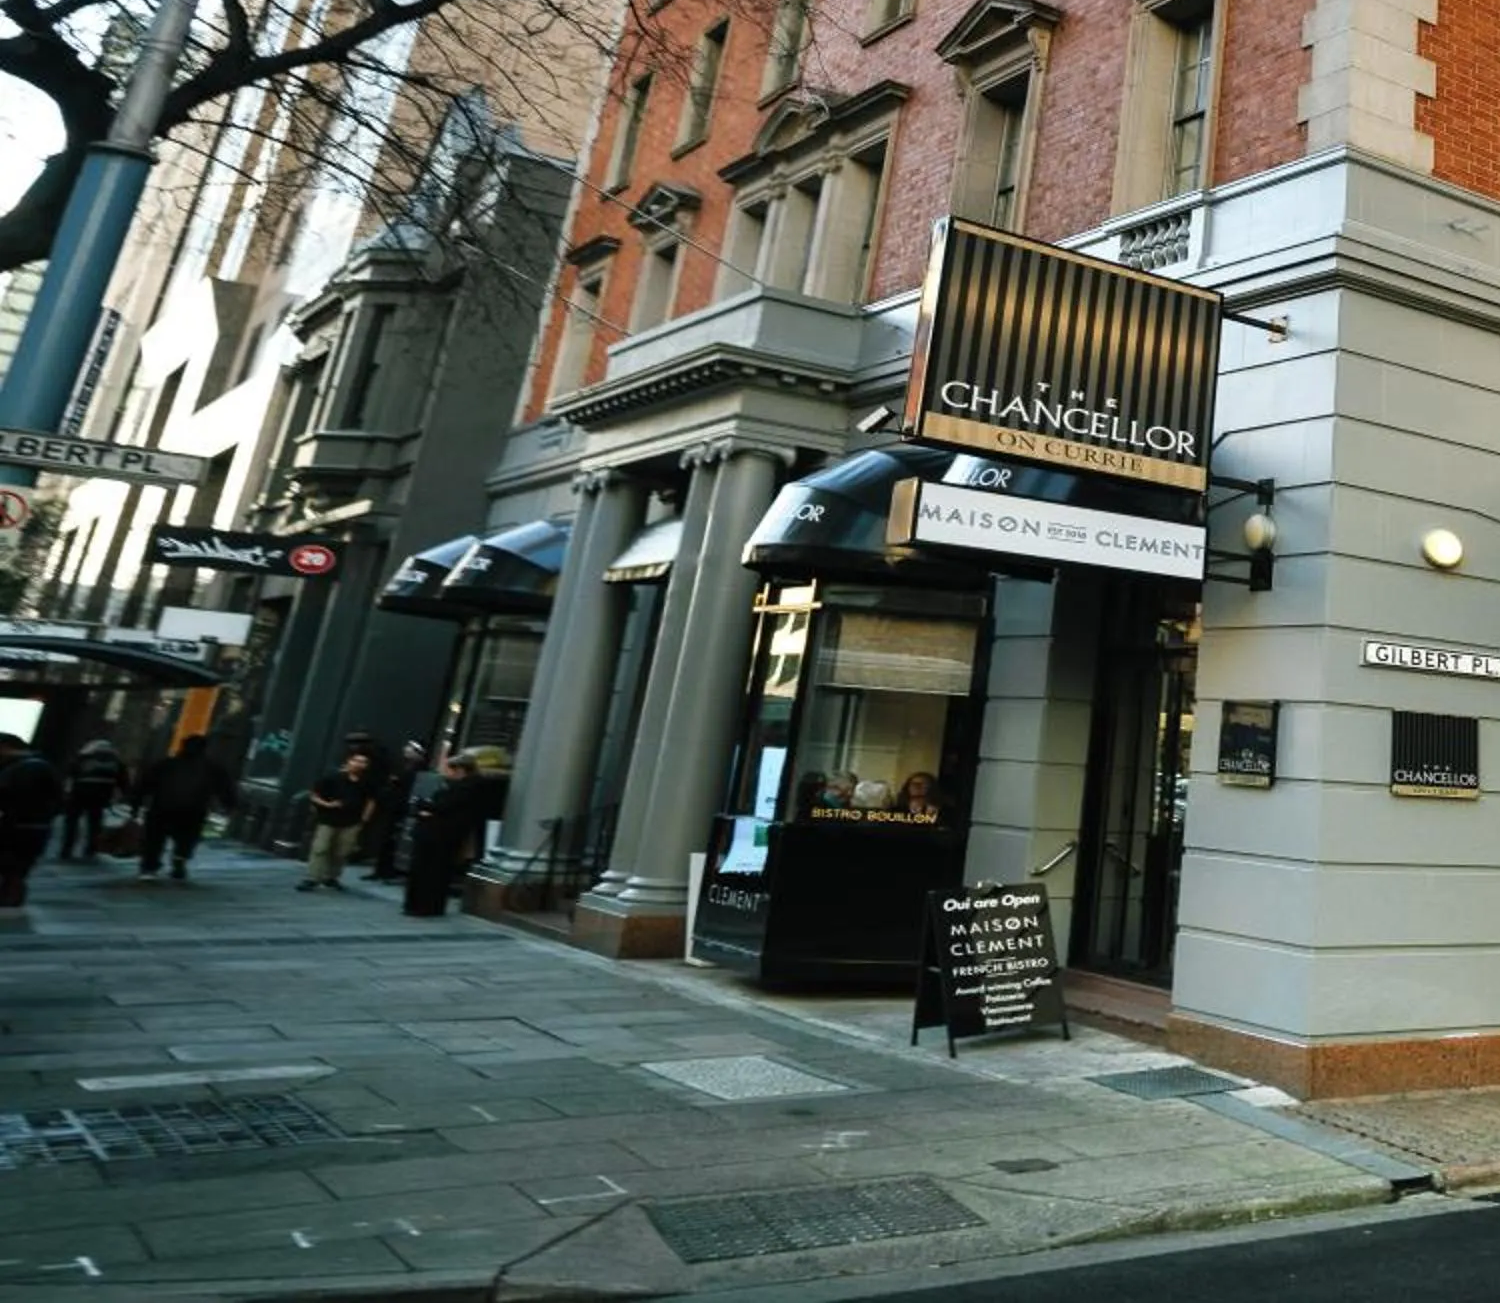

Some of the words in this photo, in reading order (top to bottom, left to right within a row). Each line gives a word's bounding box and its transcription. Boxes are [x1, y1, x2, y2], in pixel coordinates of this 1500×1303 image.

[941, 381, 1196, 457] CHANCELLOR
[120, 450, 161, 474] PL
[997, 431, 1036, 452] ON
[1043, 441, 1145, 474] CURRIE
[1095, 530, 1206, 560] CLEMENT
[1375, 646, 1463, 672] GILBERT
[1472, 658, 1499, 676] PL.
[1394, 769, 1478, 786] CHANCELLOR
[811, 807, 862, 820] BISTRO
[867, 810, 938, 825] BOUILLON
[708, 883, 761, 912] CLEMENT
[943, 898, 970, 912] Oui
[974, 897, 998, 908] are
[1002, 894, 1040, 909] Open
[950, 934, 1044, 956] CLEMENT
[952, 961, 1003, 977] FRENCH
[1006, 957, 1049, 971] BISTRO
